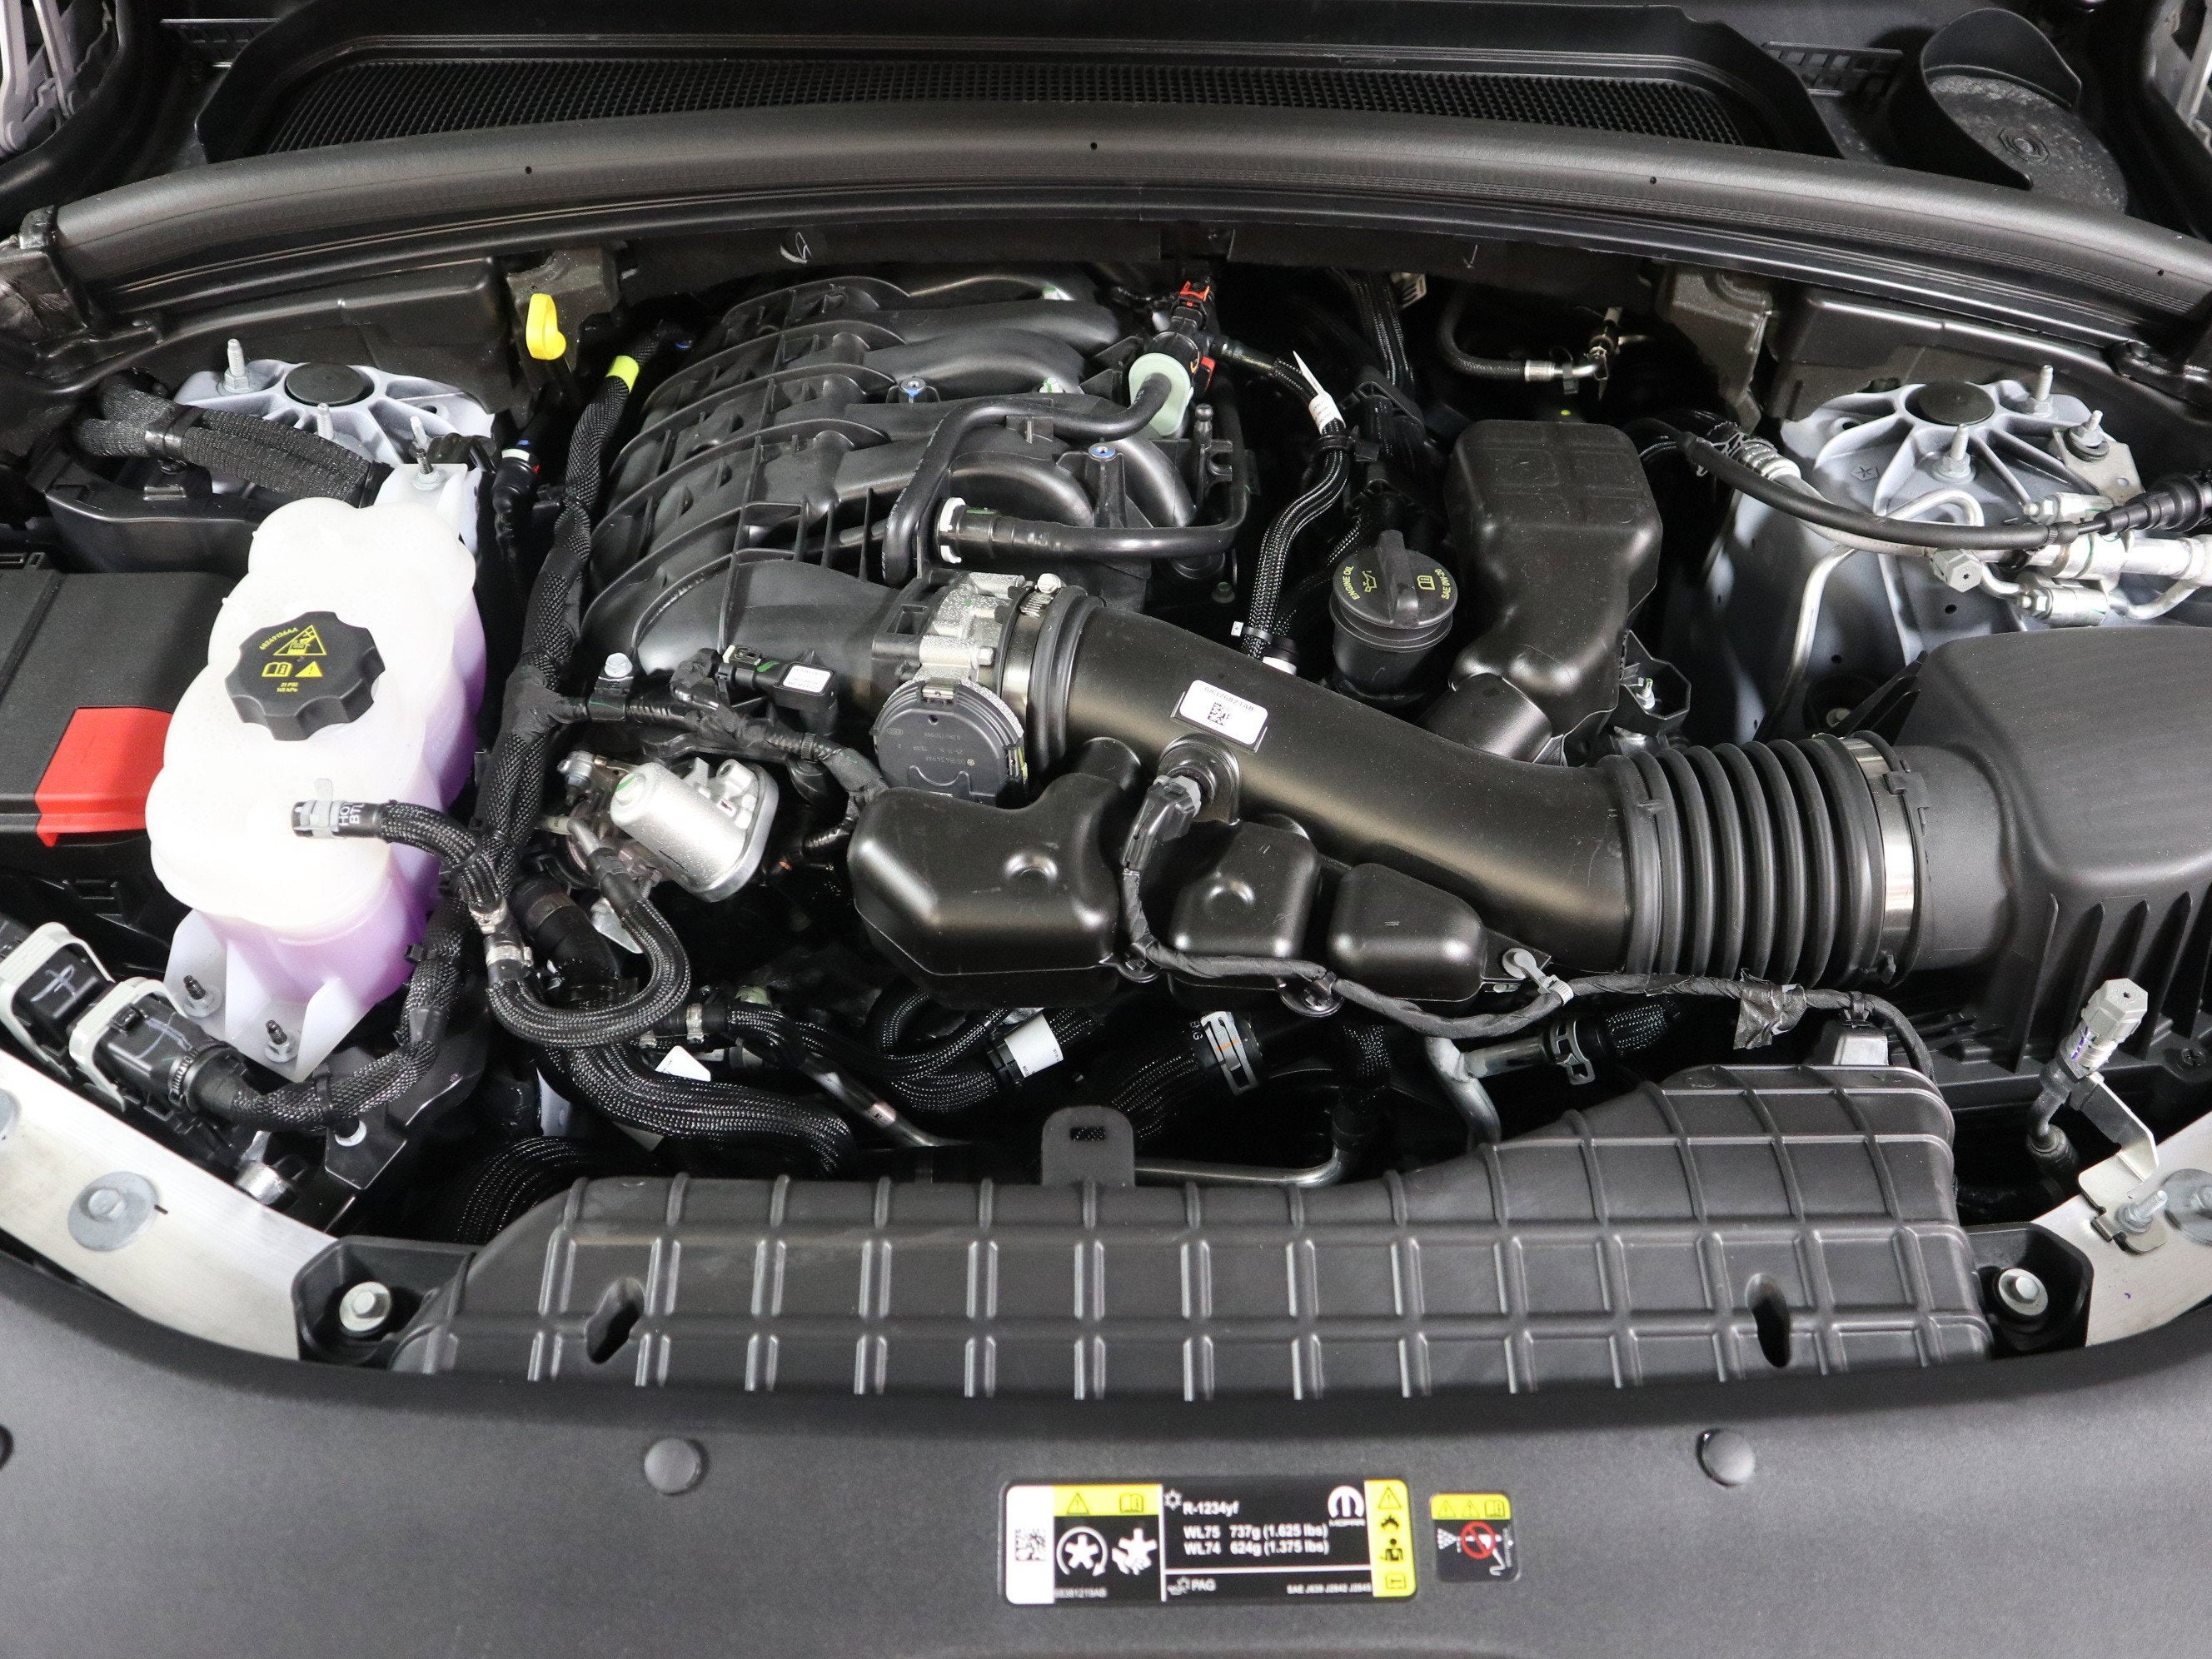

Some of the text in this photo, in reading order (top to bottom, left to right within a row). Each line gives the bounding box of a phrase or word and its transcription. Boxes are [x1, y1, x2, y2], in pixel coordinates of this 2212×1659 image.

[1343, 565, 1361, 600] ENGINE OIL
[1441, 586, 1451, 600] SAE
[1183, 1500, 1239, 1517] R-1234yf
[1183, 1523, 1328, 1541] WL75 737g (1.625 lbs)
[1183, 1539, 1330, 1557] WL74 624g (1.375 lbs)
[1192, 1578, 1216, 1592] PAG
